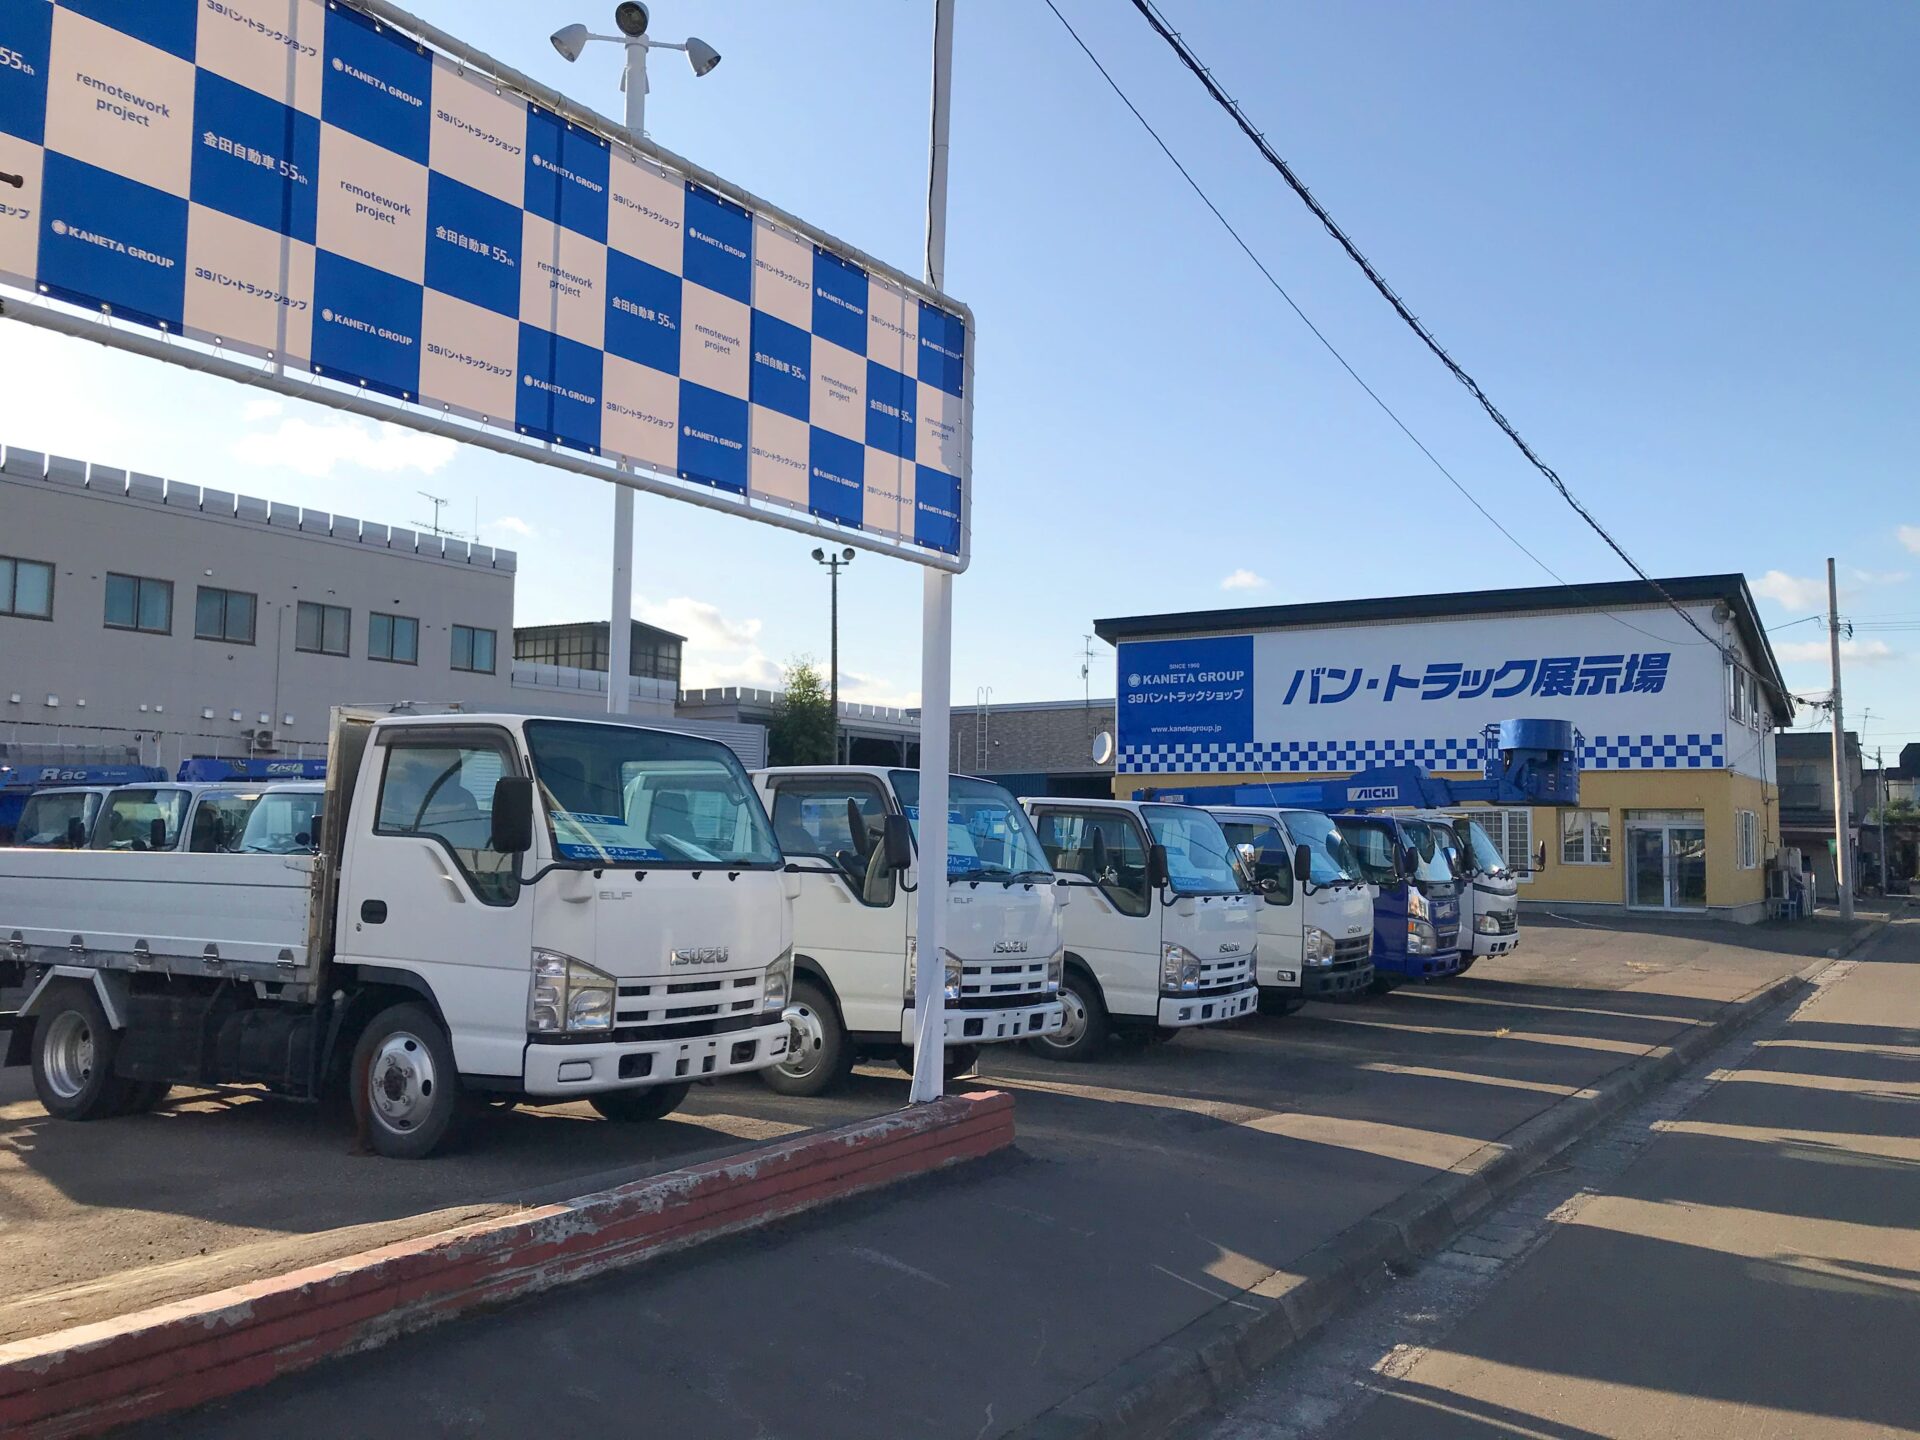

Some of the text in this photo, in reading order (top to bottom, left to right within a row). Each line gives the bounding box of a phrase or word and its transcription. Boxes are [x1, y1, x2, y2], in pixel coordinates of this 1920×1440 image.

[76, 72, 170, 118] remotework
[344, 64, 423, 108] KANETA GROUP
[96, 98, 150, 127] project
[437, 109, 521, 155] 39バン・トラックショップ
[203, 131, 275, 170] 金田自動車
[542, 159, 603, 193] KANETA GROUP
[340, 180, 411, 216] remotework
[355, 202, 396, 224] project
[68, 226, 175, 268] KANETA GROUP
[435, 225, 490, 257] 金田自動車
[697, 231, 746, 259] KANETA GROUP
[195, 266, 307, 310] 39バン・トラックショップ
[537, 261, 593, 290] remotework
[549, 279, 581, 298] project
[612, 296, 655, 321] 金田自動車
[334, 313, 413, 346] KANETA GROUP
[694, 323, 741, 347] remotework
[427, 343, 512, 378] 39バン・トラックショップ
[704, 339, 731, 356] project
[533, 379, 596, 405] KANETA GROUP
[691, 429, 743, 450] KANETA GROUP
[1142, 670, 1245, 685] KANETA GROUP
[1282, 652, 1671, 705] バン・トラック展示場
[1127, 688, 1245, 704] 39バン・トラックショップ
[1150, 724, 1222, 734] www.kanetagroup.jp
[40, 767, 88, 780] Rac
[1357, 787, 1396, 799] AICHI
[599, 891, 633, 901] ELF
[670, 946, 729, 966] ISUZU
[993, 939, 1028, 954] ISUZU
